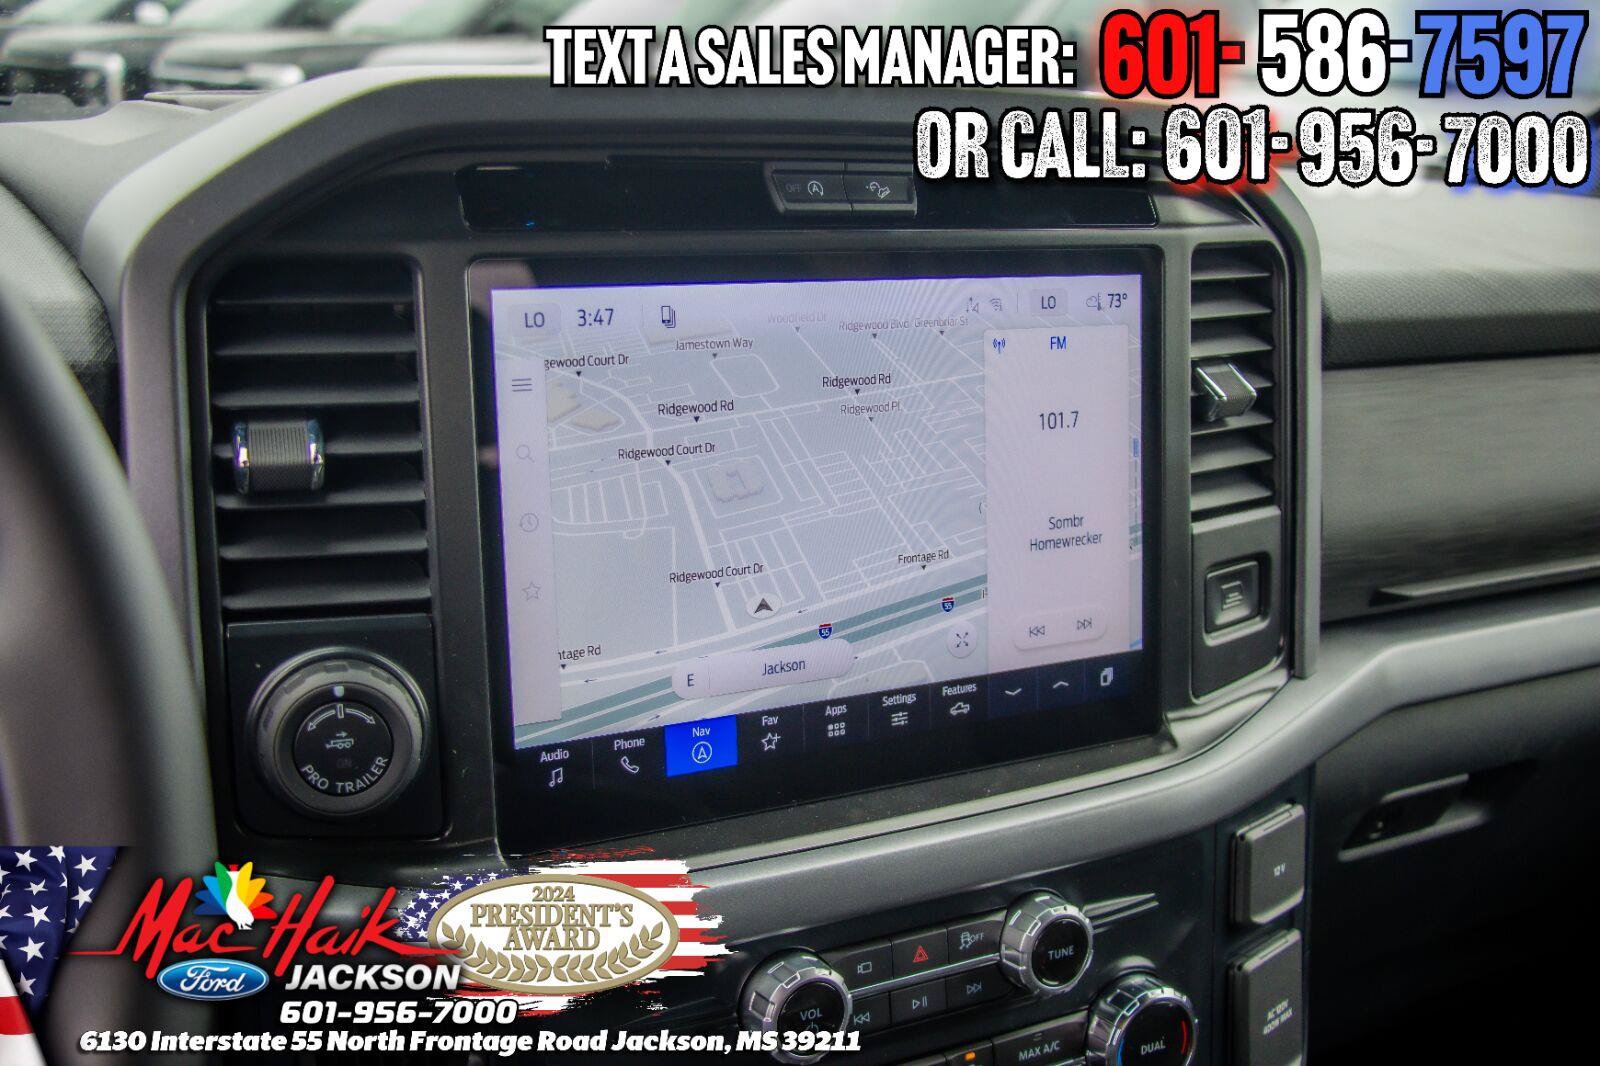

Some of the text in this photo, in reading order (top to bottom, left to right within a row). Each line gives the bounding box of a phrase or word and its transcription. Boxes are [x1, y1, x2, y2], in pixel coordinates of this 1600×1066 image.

[1041, 296, 1057, 310] LO
[524, 311, 545, 328] LO
[577, 308, 614, 327] 3:47
[959, 316, 969, 327] St
[838, 320, 889, 333] Ridgewood
[675, 337, 754, 351] Jamestown Way
[1050, 336, 1067, 351] FM
[587, 354, 615, 367] Court
[618, 353, 630, 365] Dr
[822, 372, 891, 389] Ridgewood Rd
[657, 400, 735, 417] Ridgewood Rd
[840, 401, 889, 416] Ridgewood
[1039, 411, 1080, 431] 101.7
[618, 443, 716, 461] Ridgewood Court Dr
[1048, 514, 1084, 531] Sombr
[1029, 531, 1103, 552] Homewrecker
[897, 549, 949, 566] Frontage Rd
[669, 563, 764, 584] Ridgewood Court Dr
[944, 602, 953, 610] 55
[820, 627, 831, 638] 55
[587, 645, 601, 656] Rd
[761, 659, 806, 676] Jackson
[687, 673, 695, 687] E
[942, 682, 977, 697] Features
[882, 690, 917, 707] Settings
[825, 703, 848, 719] Apps
[762, 714, 779, 726] Fav
[692, 726, 711, 738] Nav
[613, 736, 646, 750] Phone
[540, 748, 570, 763] Audio
[301, 755, 390, 793] PRO TRAILER
[1047, 944, 1075, 962] TUNE
[800, 1007, 823, 1021] VOL
[1018, 1039, 1061, 1062] MAX A/C
[1140, 1038, 1167, 1056] DUAL
